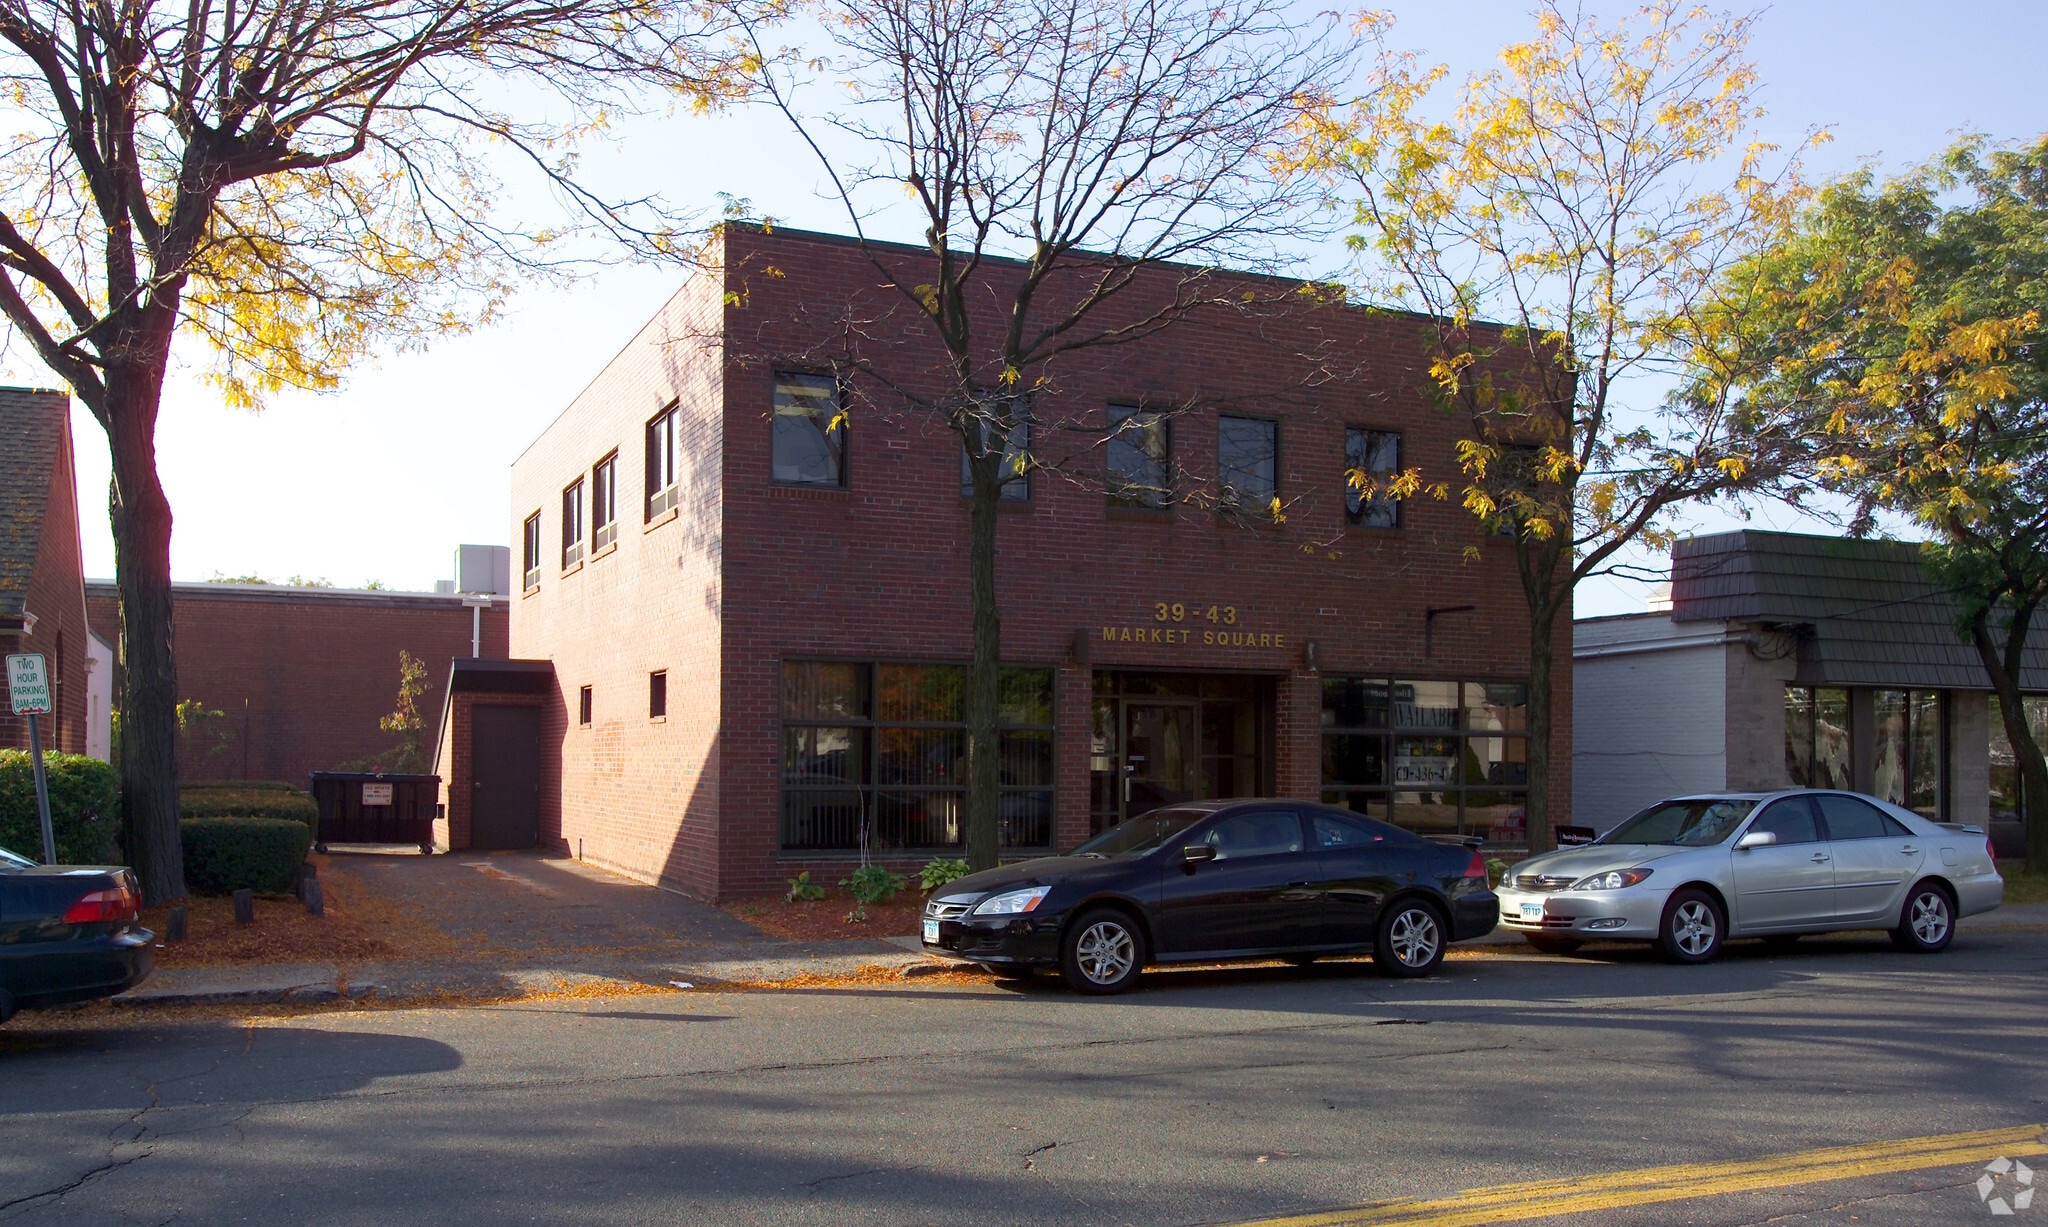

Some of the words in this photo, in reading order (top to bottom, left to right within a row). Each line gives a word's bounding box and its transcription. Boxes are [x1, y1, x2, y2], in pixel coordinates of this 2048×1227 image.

[1102, 626, 1190, 644] MARKET
[1203, 630, 1285, 648] SQUARE
[17, 660, 34, 669] TWO
[16, 673, 38, 682] HOUR
[13, 685, 45, 695] PARKING
[15, 698, 46, 708] 8AM-6PM
